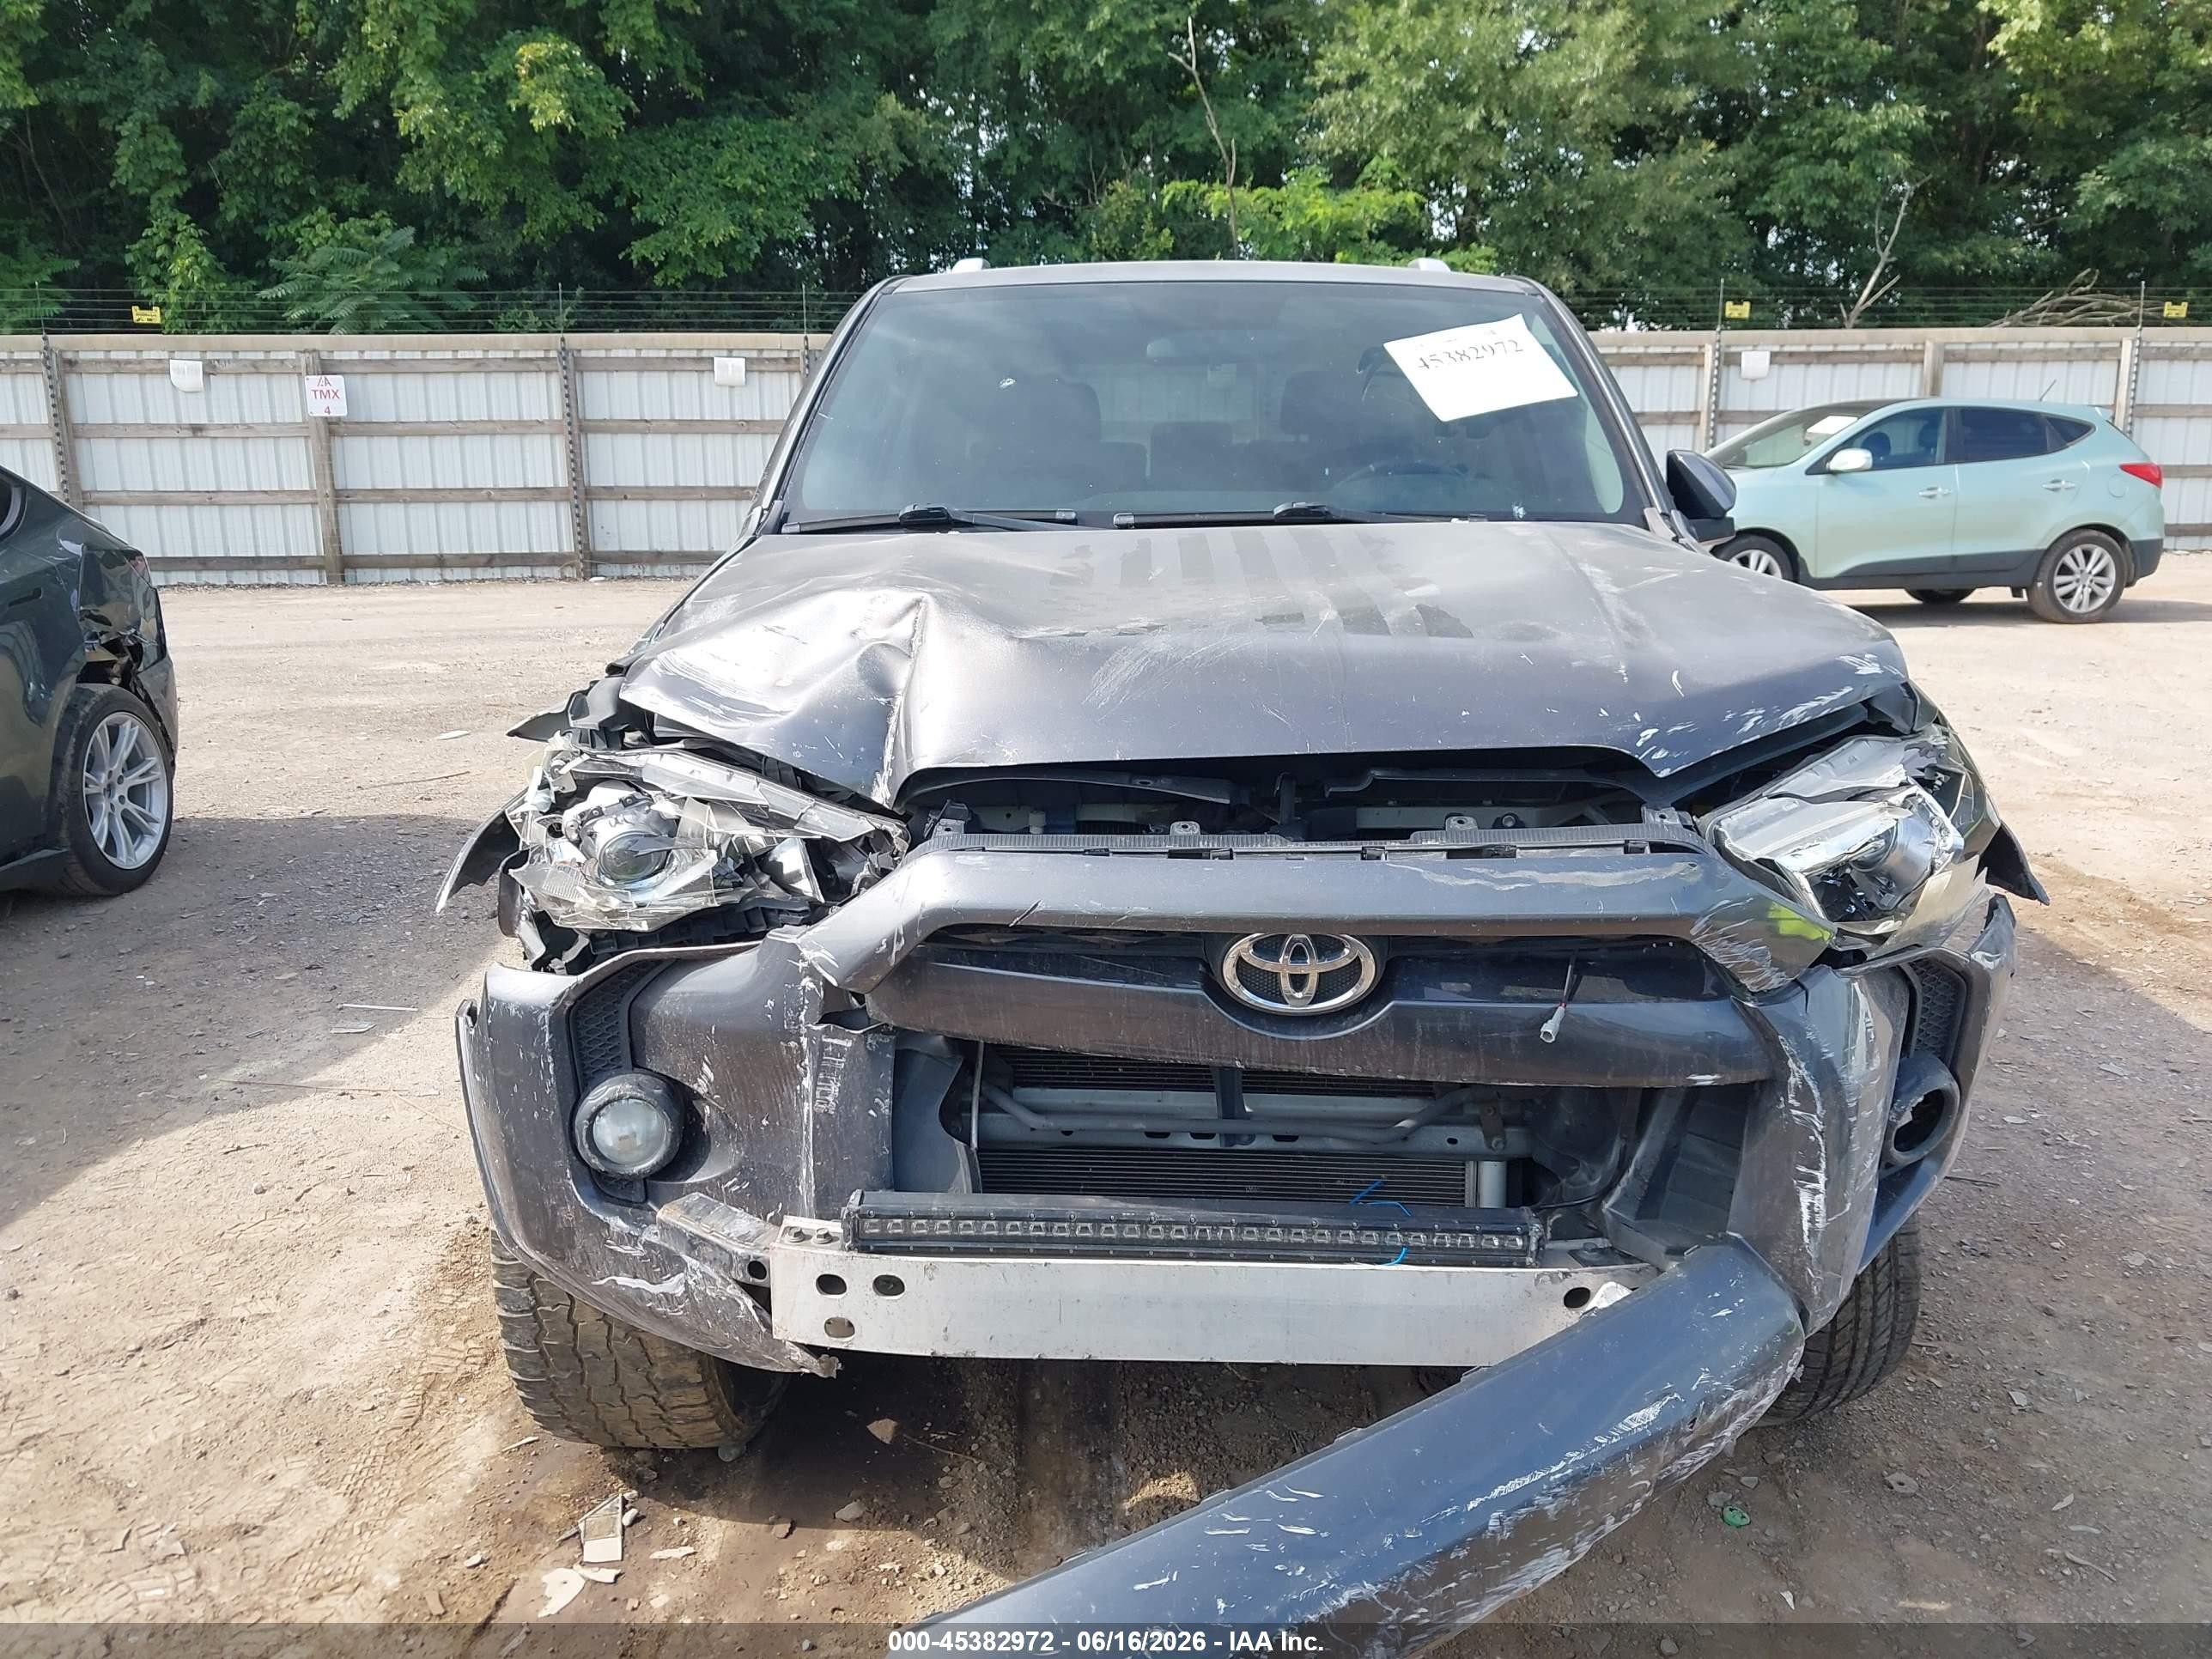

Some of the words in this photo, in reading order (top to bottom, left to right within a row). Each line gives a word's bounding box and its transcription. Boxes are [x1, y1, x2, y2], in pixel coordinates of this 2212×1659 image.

[1418, 339, 1524, 369] 45382972
[311, 389, 340, 399] TMX
[324, 405, 331, 415] 4
